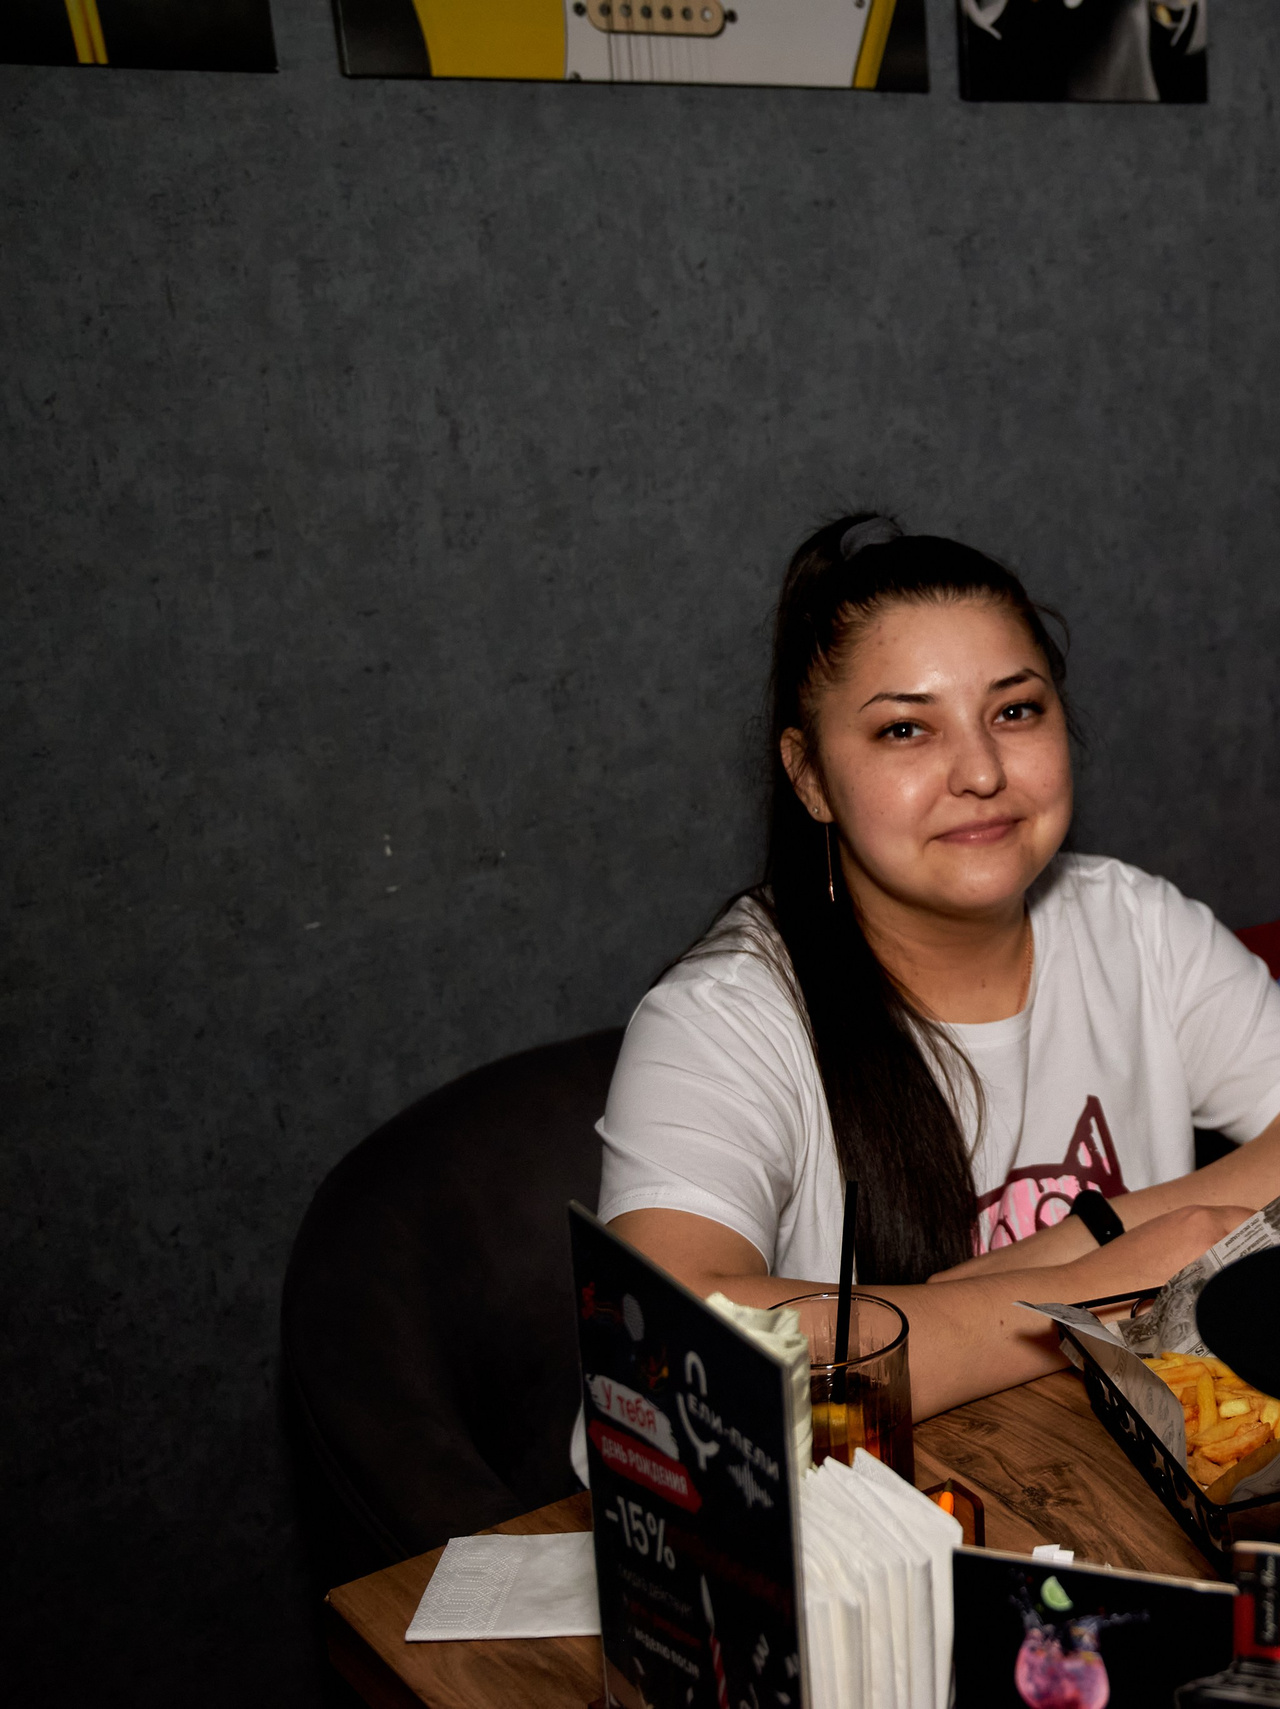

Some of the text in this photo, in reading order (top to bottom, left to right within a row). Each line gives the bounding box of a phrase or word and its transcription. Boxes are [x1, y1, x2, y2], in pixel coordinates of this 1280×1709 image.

[618, 1395, 657, 1432] тебя
[601, 1436, 688, 1495] ДЕНЬ РОЖДЕНИЯ
[604, 1495, 676, 1571] -15%
